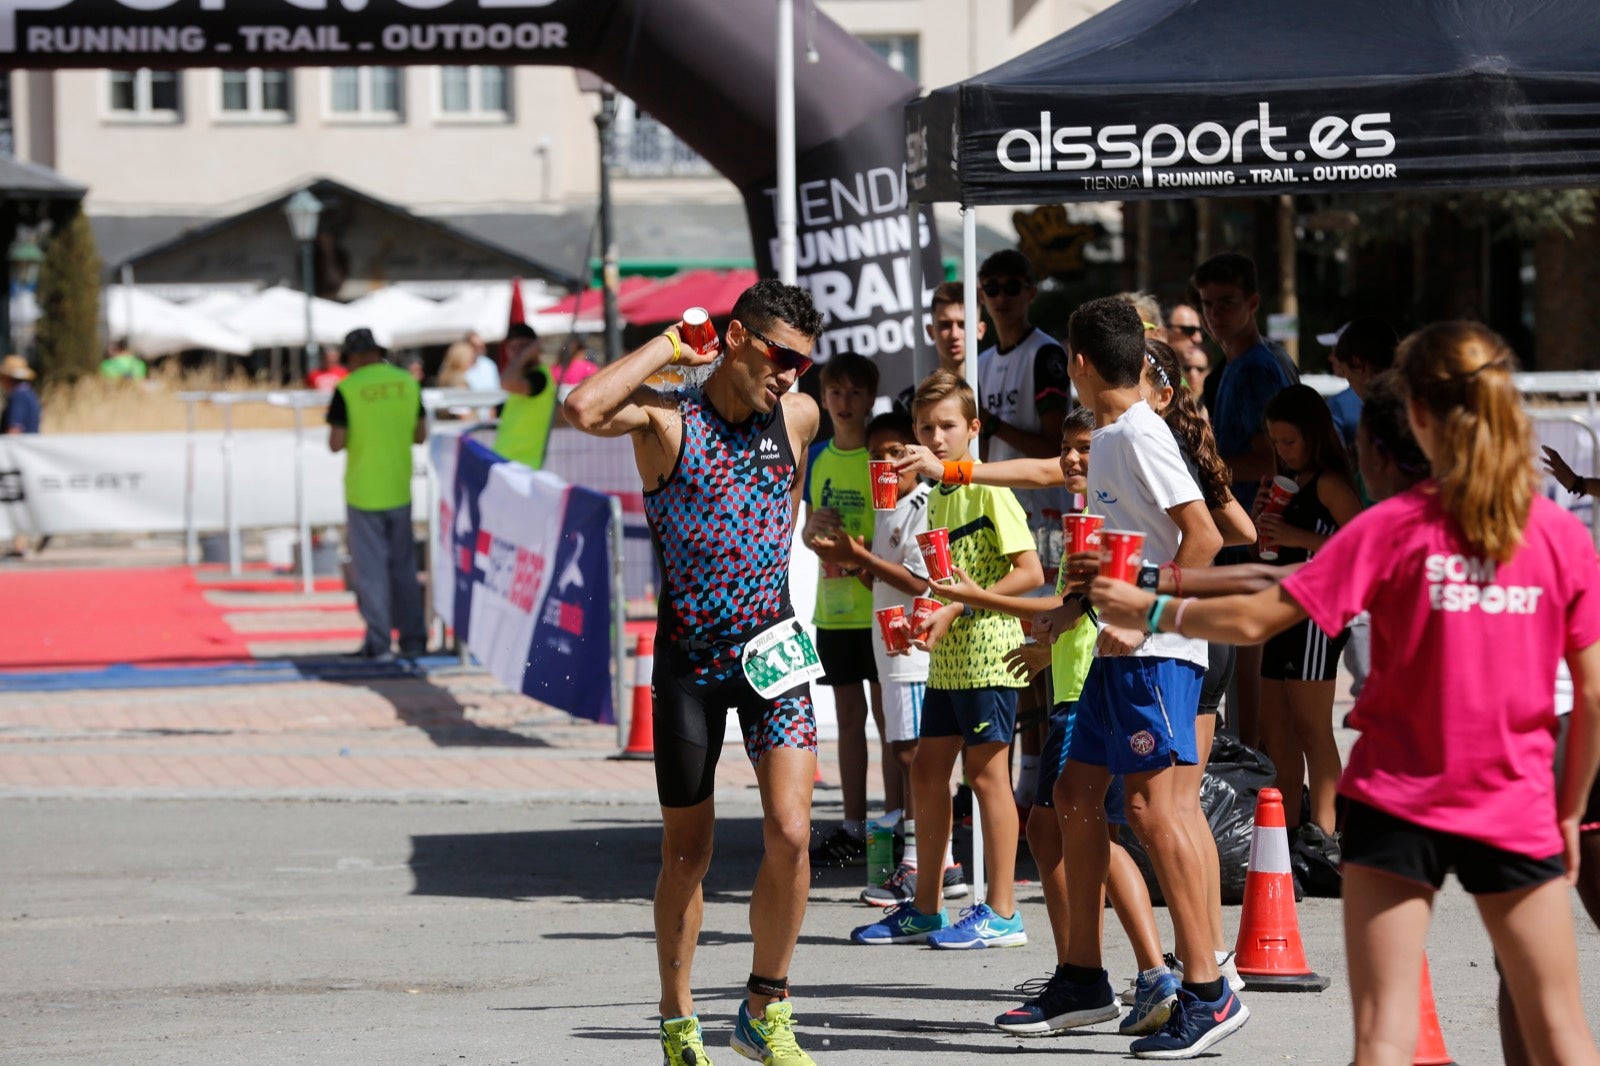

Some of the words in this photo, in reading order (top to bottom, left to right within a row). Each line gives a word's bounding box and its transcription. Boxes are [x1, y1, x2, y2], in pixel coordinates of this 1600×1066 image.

[27, 26, 206, 52] RUNNING
[238, 26, 349, 51] TRAIL
[381, 23, 568, 49] OUTDOOR
[996, 102, 1397, 188] alssport.es
[1080, 174, 1140, 190] TIENDA
[1157, 171, 1236, 187] RUNNING
[1250, 168, 1299, 184] TRAIL
[1313, 163, 1397, 181] OUTDOOR
[796, 256, 935, 326] RAI
[760, 452, 780, 460] mobel
[1425, 553, 1496, 583] SOM
[1428, 583, 1544, 615] ESPORT
[765, 638, 805, 674] 19
